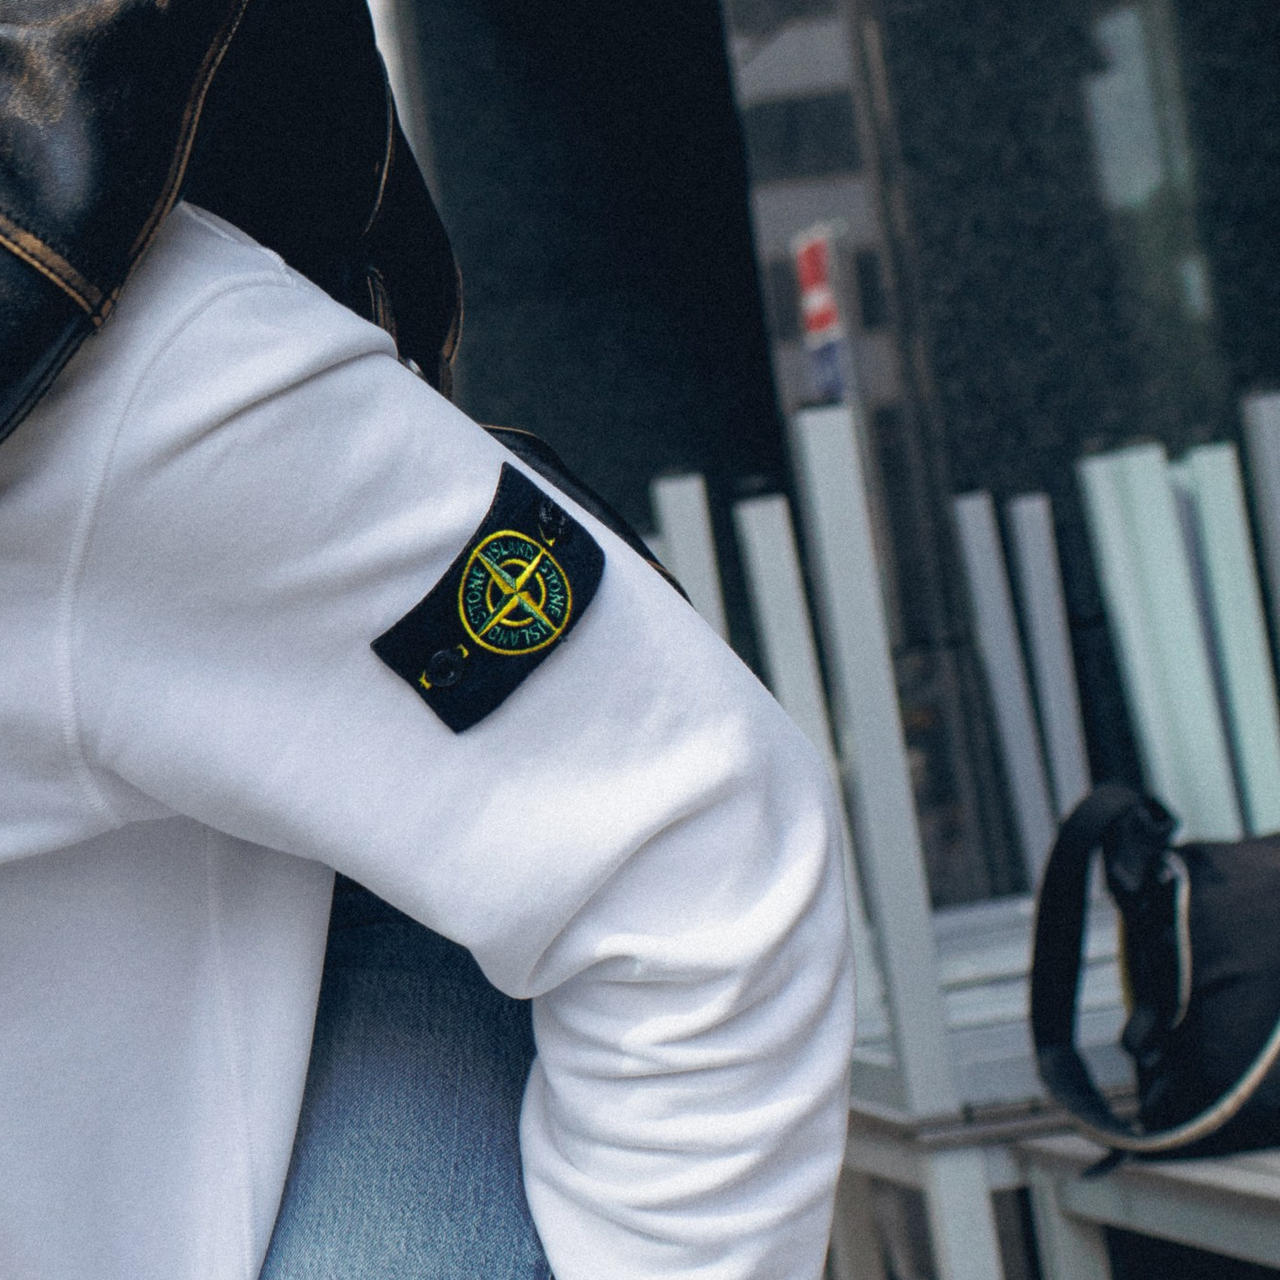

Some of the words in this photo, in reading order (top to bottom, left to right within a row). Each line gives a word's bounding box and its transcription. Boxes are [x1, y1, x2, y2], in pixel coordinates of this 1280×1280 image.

[466, 565, 487, 624] STONE
[486, 541, 535, 562] ISLAND
[539, 560, 565, 618] STONE
[488, 621, 547, 647] ISLAND
